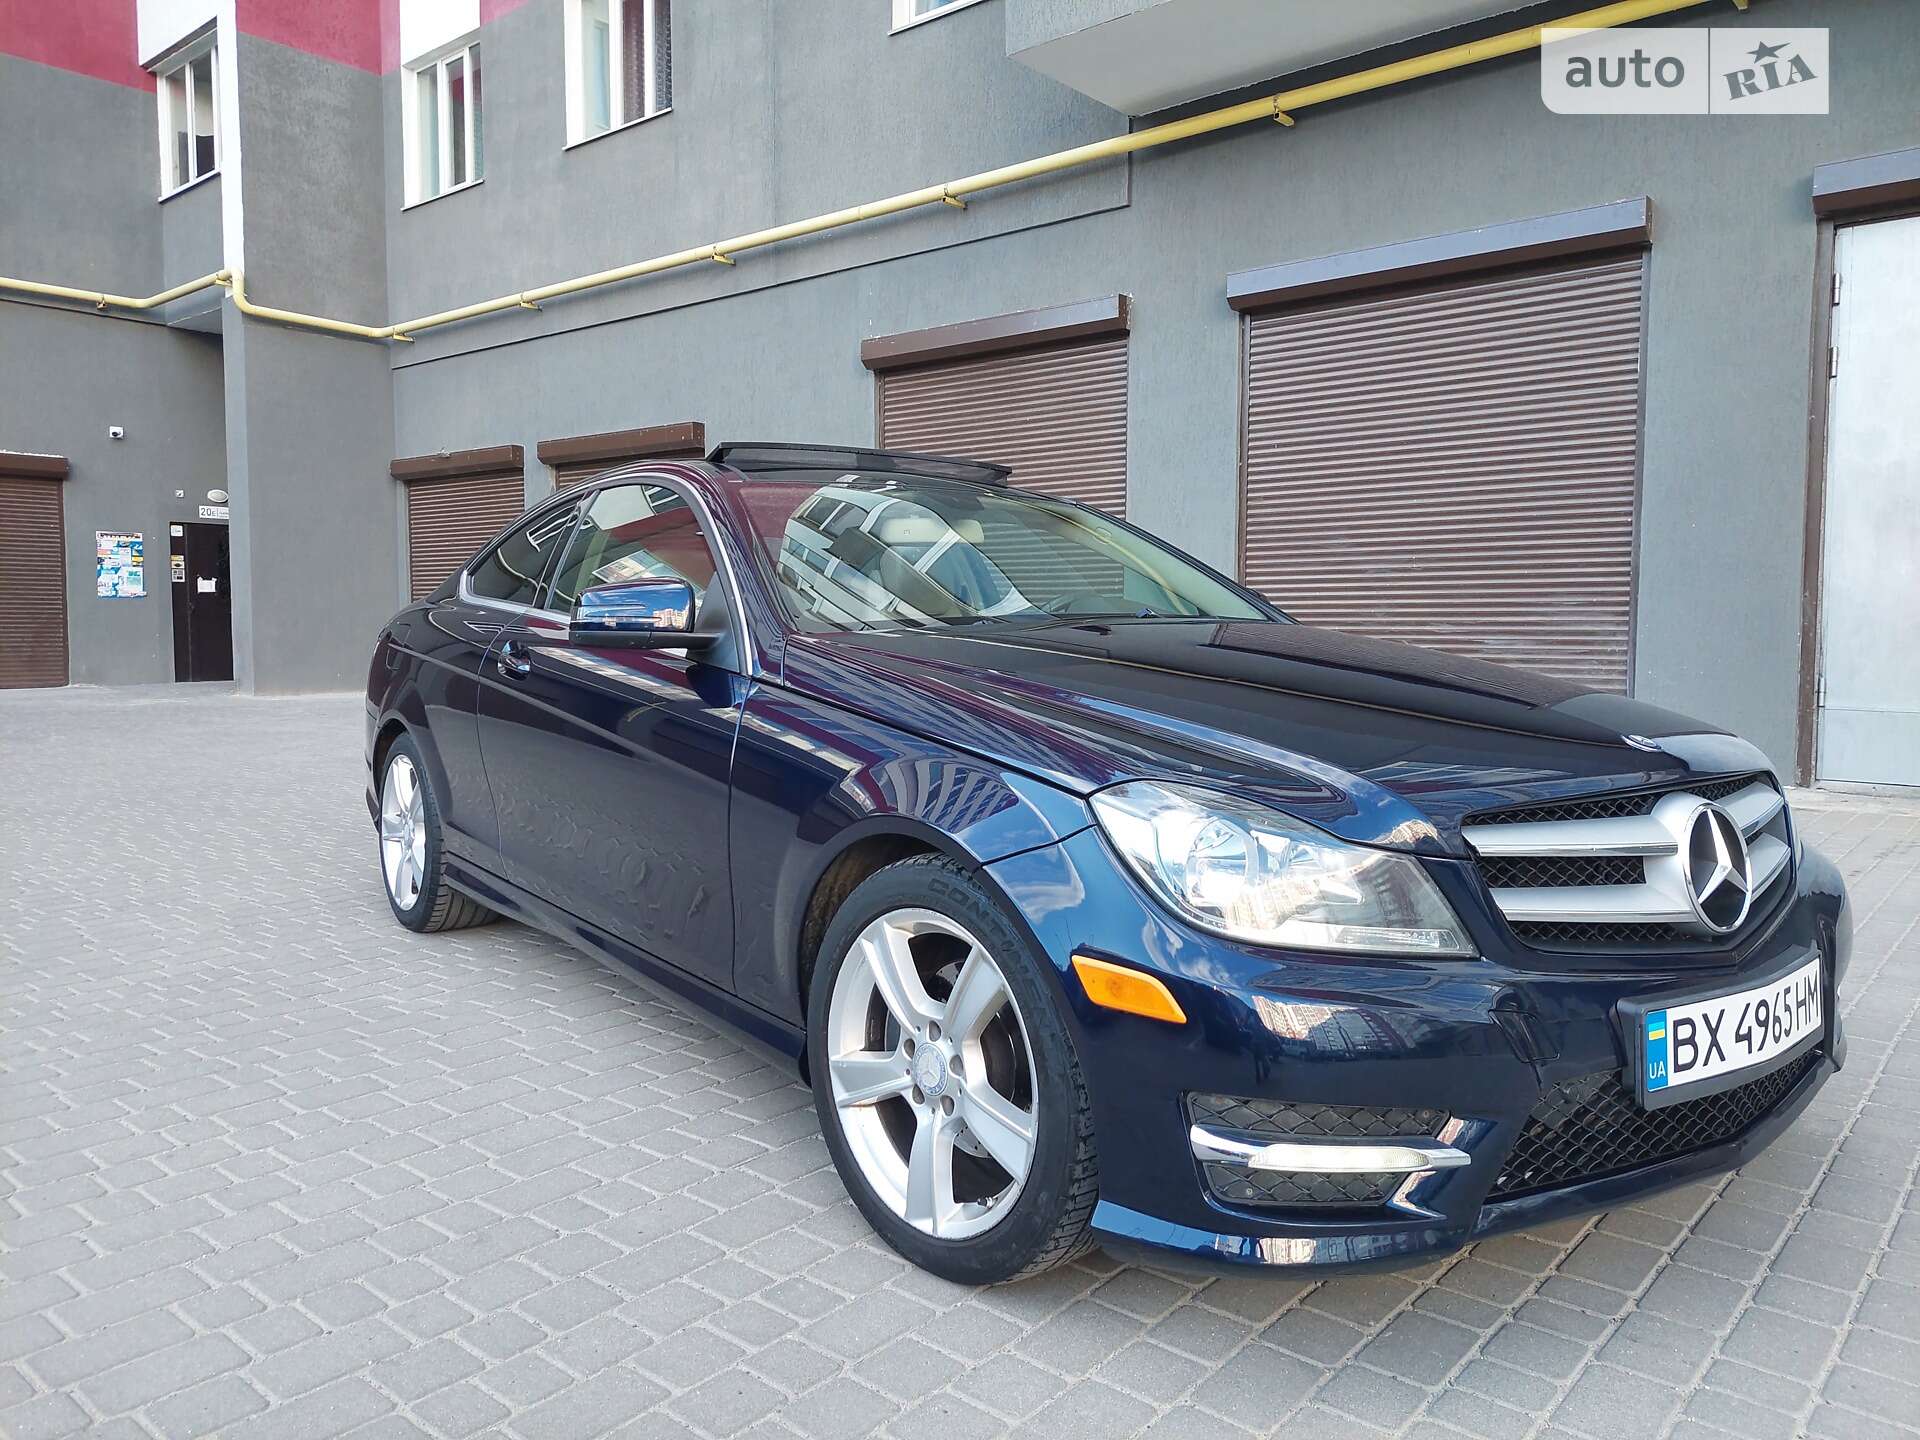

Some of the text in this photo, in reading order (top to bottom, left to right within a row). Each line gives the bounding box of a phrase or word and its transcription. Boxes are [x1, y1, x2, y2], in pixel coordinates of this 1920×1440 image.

[1673, 970, 1819, 1073] BX 4965 HM
[1649, 1061, 1666, 1080] UA
